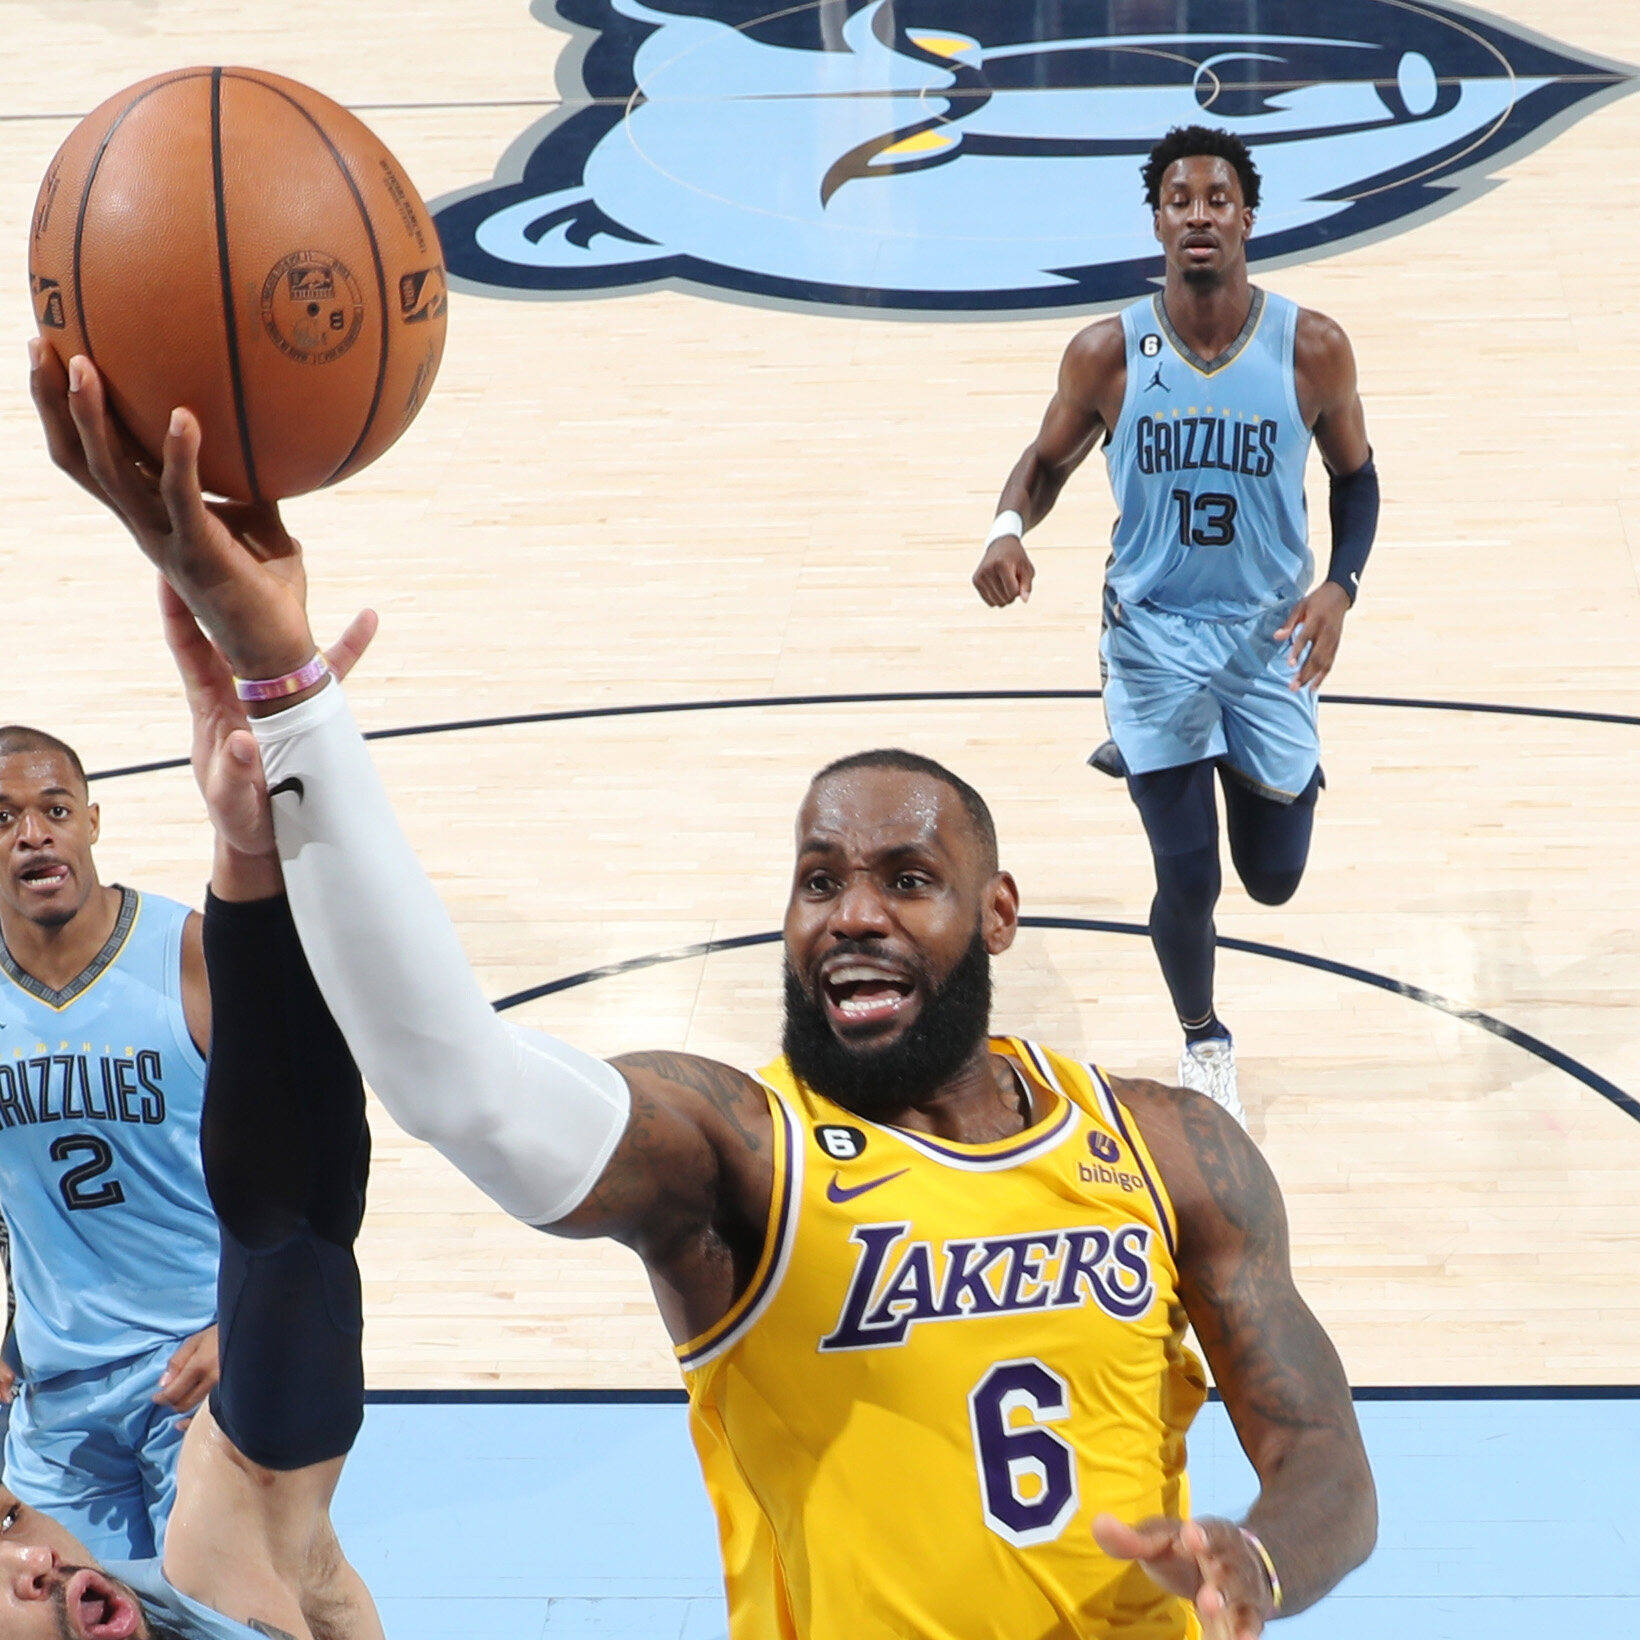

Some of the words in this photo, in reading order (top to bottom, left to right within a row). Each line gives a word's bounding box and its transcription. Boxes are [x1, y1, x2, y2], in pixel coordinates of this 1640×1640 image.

[1143, 335, 1161, 357] 6
[1136, 415, 1278, 479] GRIZZLIES
[1172, 488, 1238, 547] 13
[48, 1133, 127, 1212] 2
[822, 1128, 858, 1158] 6
[1078, 1161, 1145, 1194] bibigo
[818, 1219, 1159, 1355] LAKERS
[966, 1355, 1082, 1549] 6
